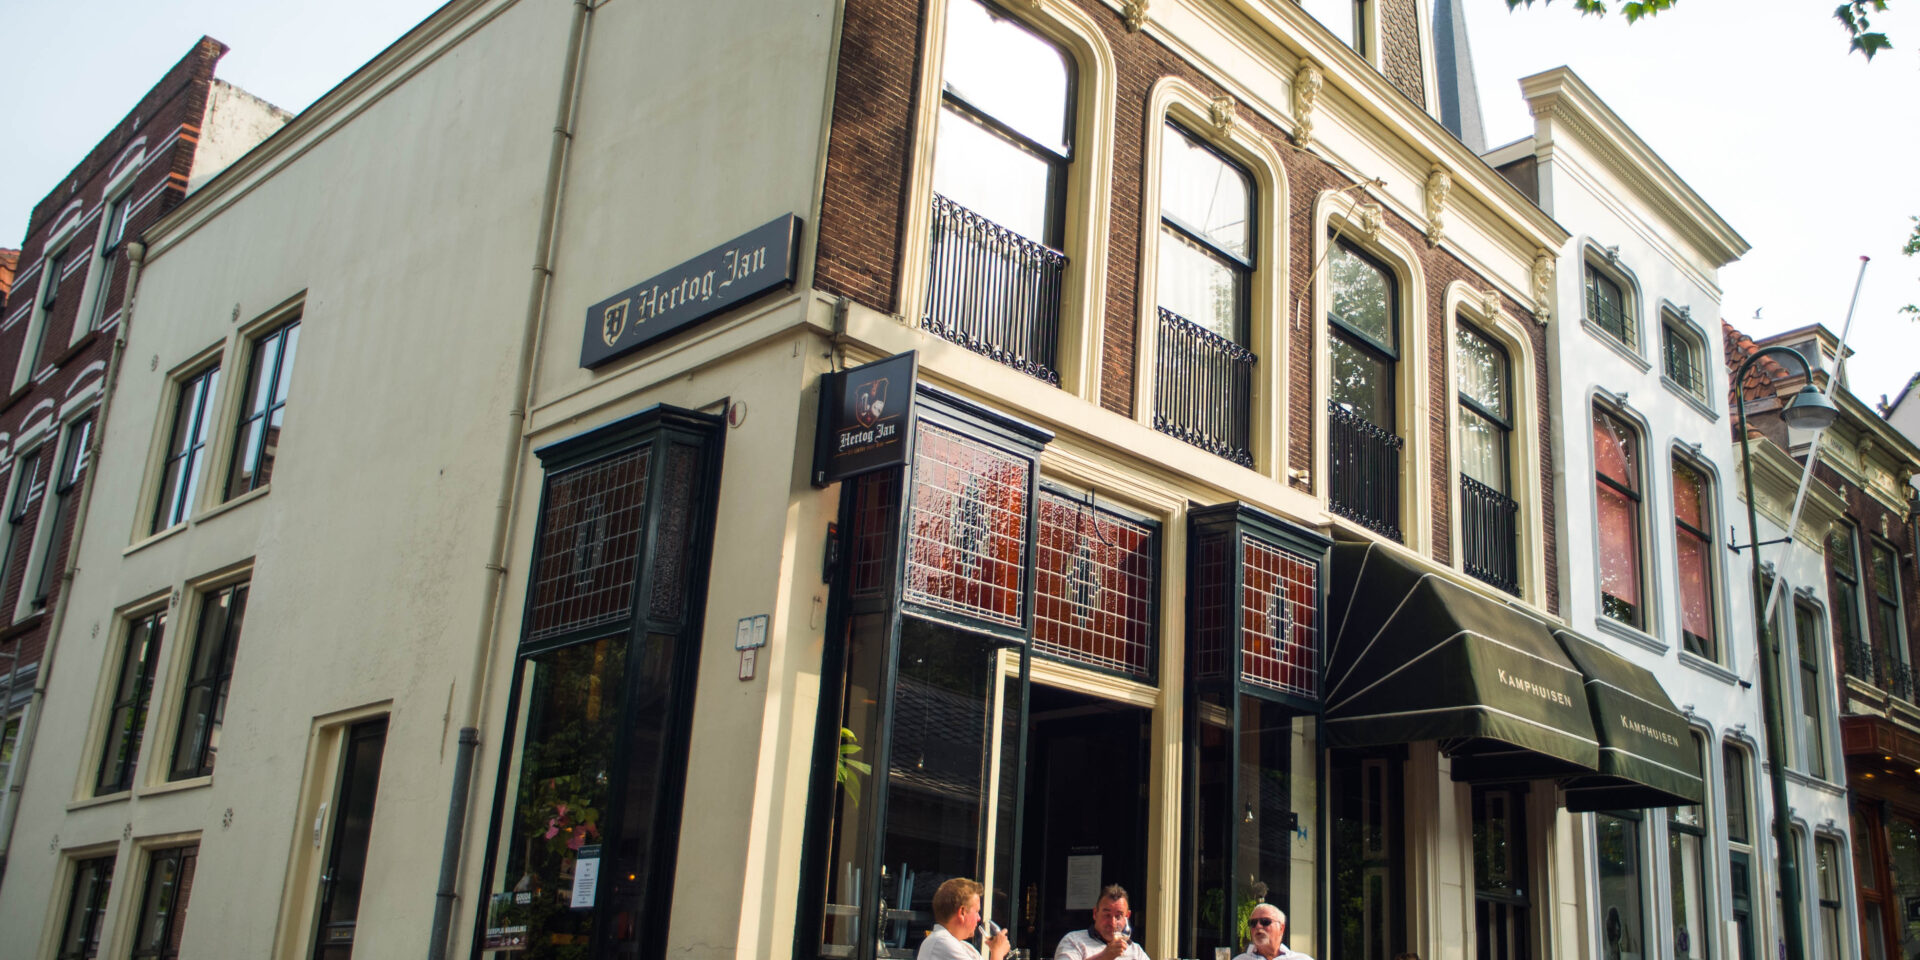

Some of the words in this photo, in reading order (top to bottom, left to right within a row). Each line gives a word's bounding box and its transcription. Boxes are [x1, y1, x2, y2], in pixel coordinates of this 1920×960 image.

[633, 269, 716, 335] Hertog
[718, 246, 767, 298] Jan
[839, 430, 874, 452] Hertog
[875, 423, 896, 443] Jan
[1497, 668, 1573, 708] KAMPHUISEN
[1620, 714, 1680, 747] KAMPHUISEN
